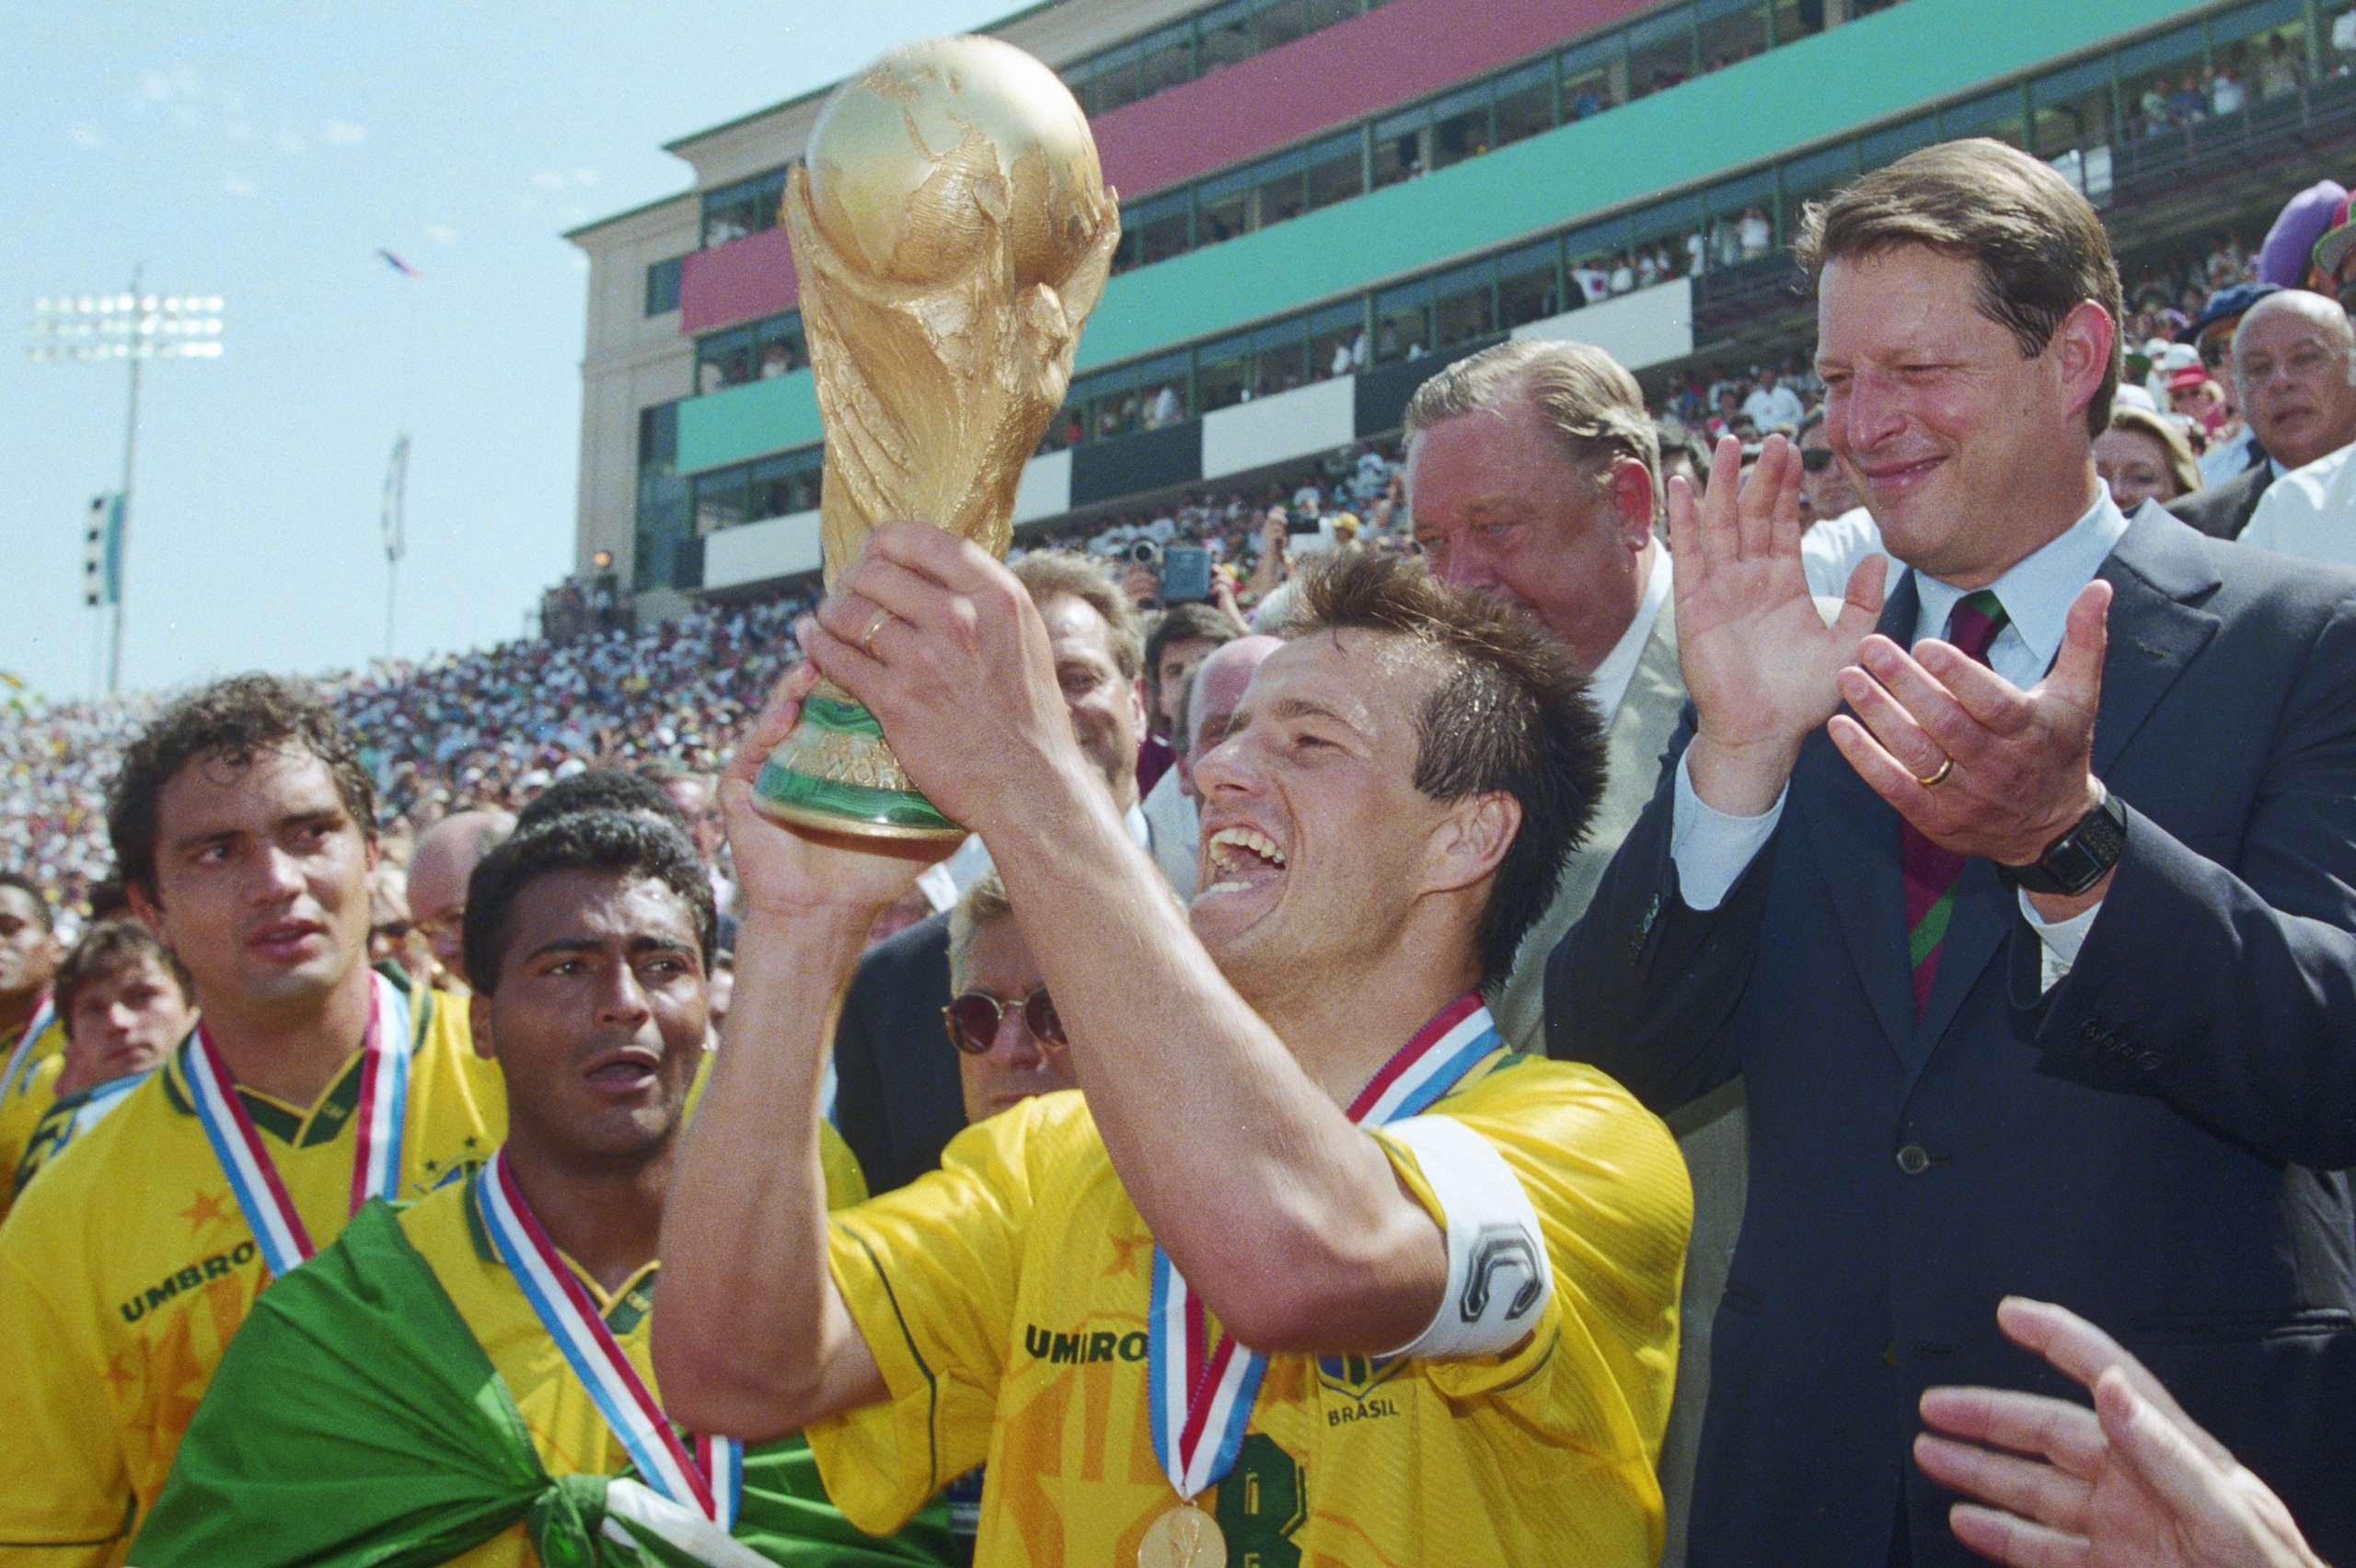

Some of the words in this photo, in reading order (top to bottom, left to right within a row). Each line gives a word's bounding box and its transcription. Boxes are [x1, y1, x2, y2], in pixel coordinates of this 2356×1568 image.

[121, 1241, 255, 1322] UMBRO
[1025, 1323, 1149, 1365] UMRO
[1328, 1399, 1401, 1427] BRASIL
